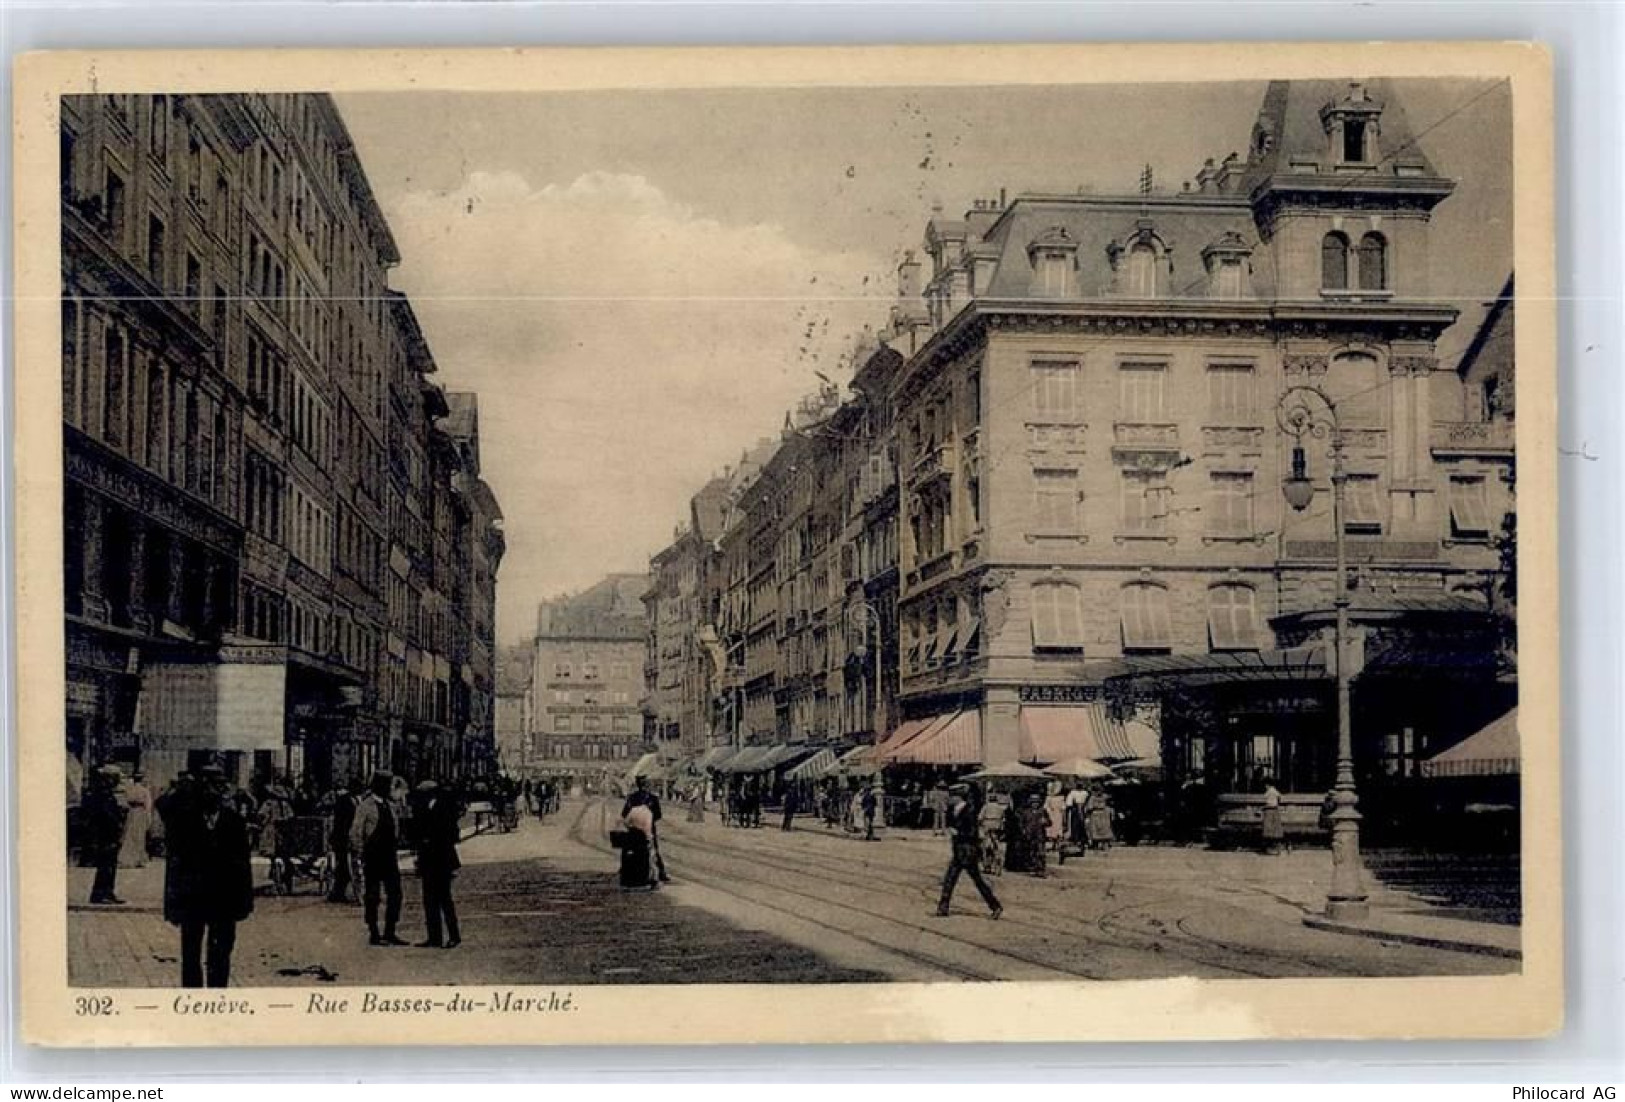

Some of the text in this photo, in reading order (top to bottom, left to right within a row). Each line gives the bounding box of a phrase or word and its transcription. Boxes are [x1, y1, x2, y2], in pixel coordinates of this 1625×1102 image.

[75, 997, 121, 1017] 302.
[172, 994, 257, 1016] Genève.
[307, 993, 349, 1014] Rue
[362, 991, 579, 1013] Basses-du-Marché.
